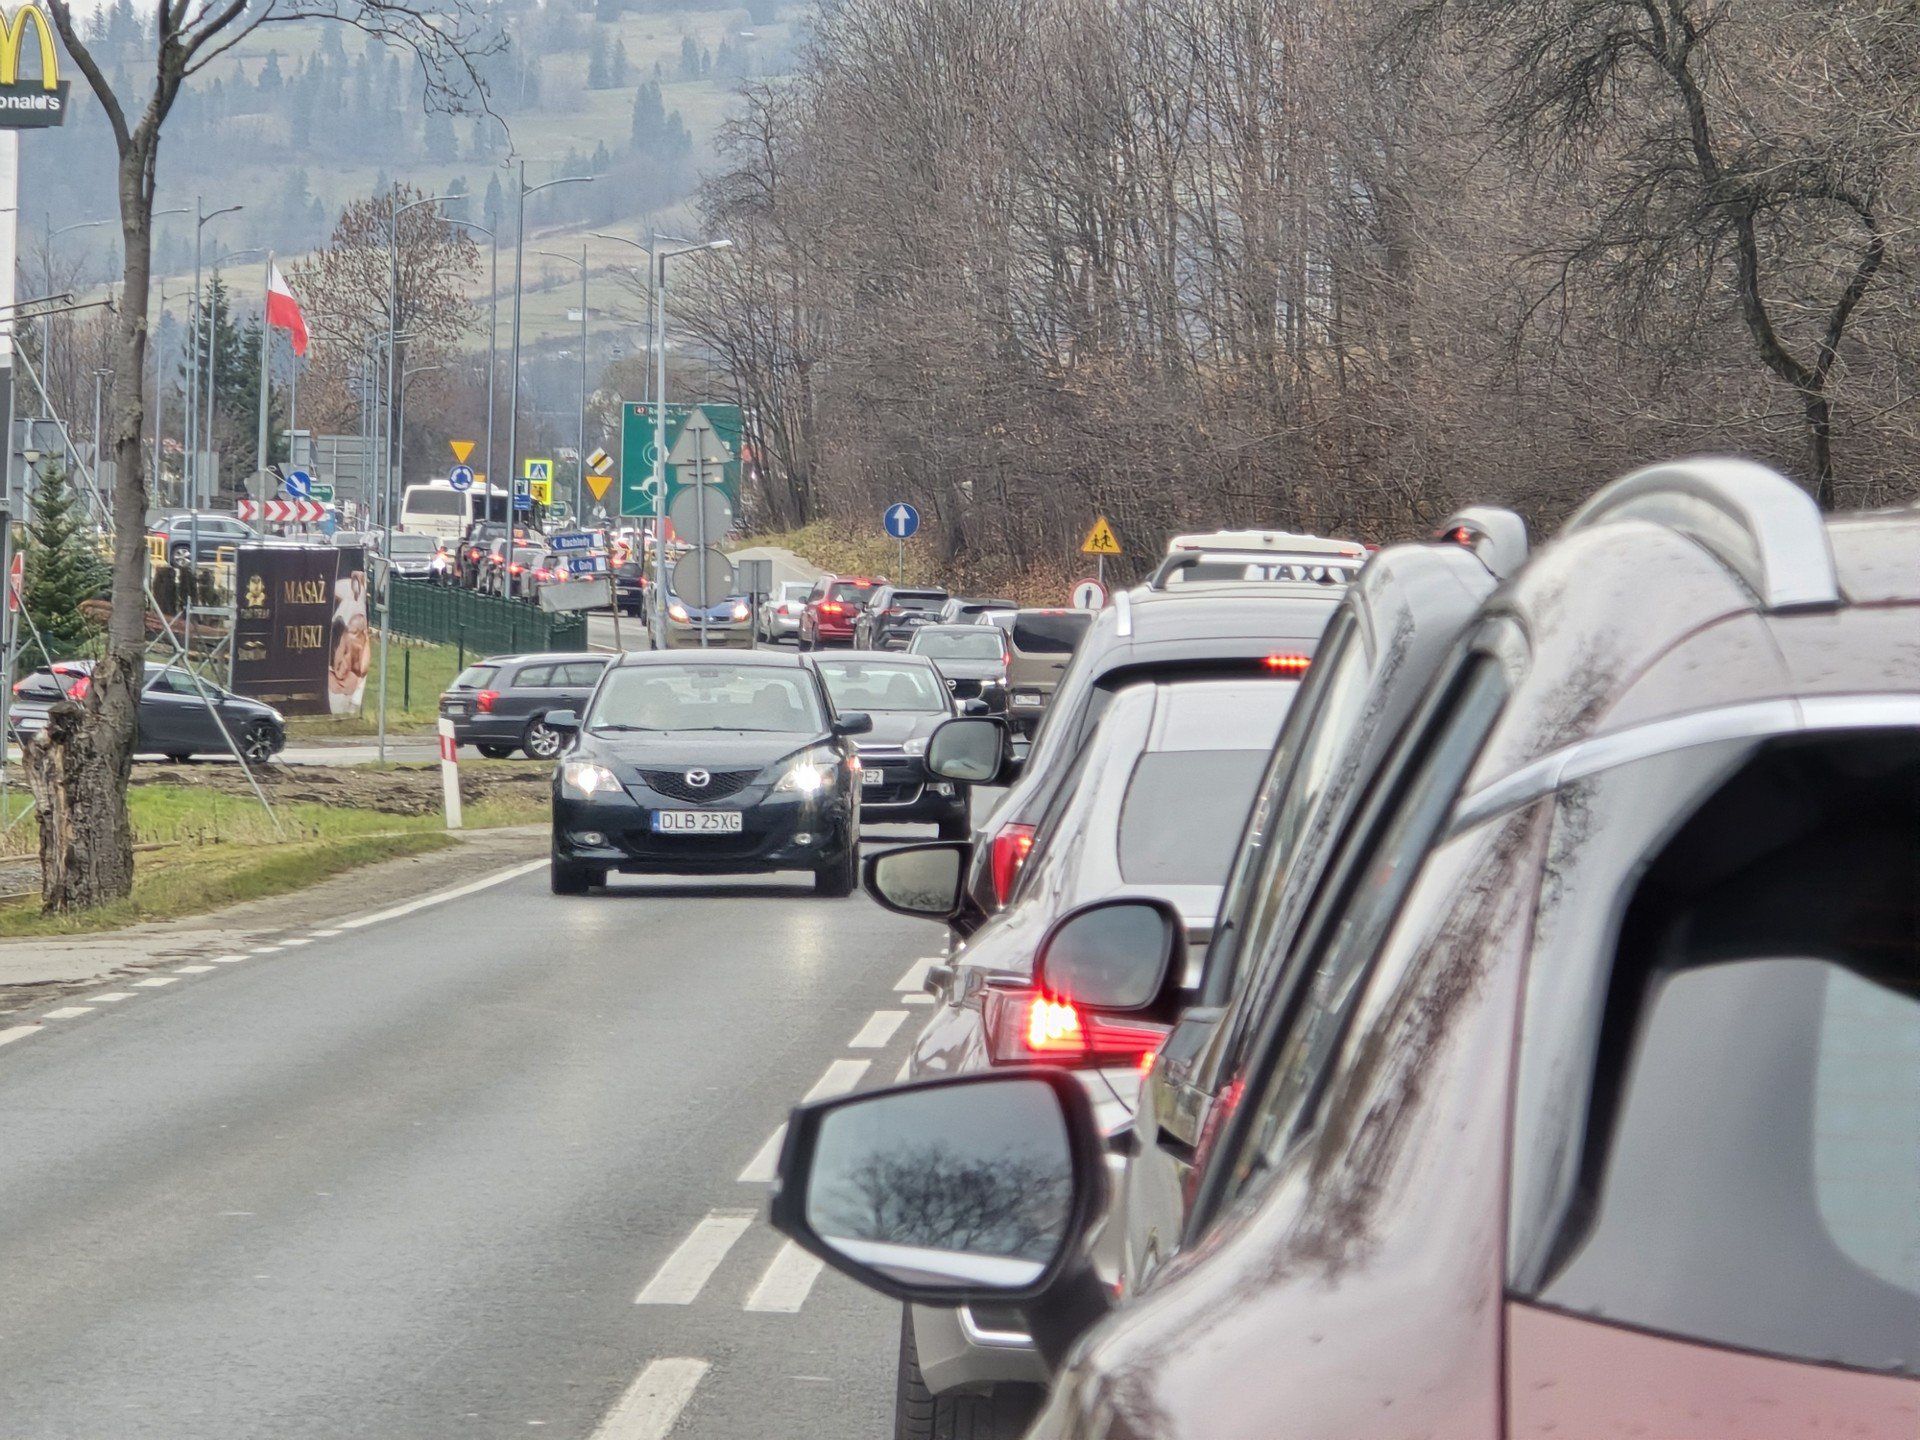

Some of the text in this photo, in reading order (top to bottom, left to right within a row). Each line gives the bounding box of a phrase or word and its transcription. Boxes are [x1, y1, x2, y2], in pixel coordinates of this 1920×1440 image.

[284, 573, 326, 604] MASAŻ
[286, 625, 323, 653] TAJSKI
[662, 813, 740, 829] DLB 25XG
